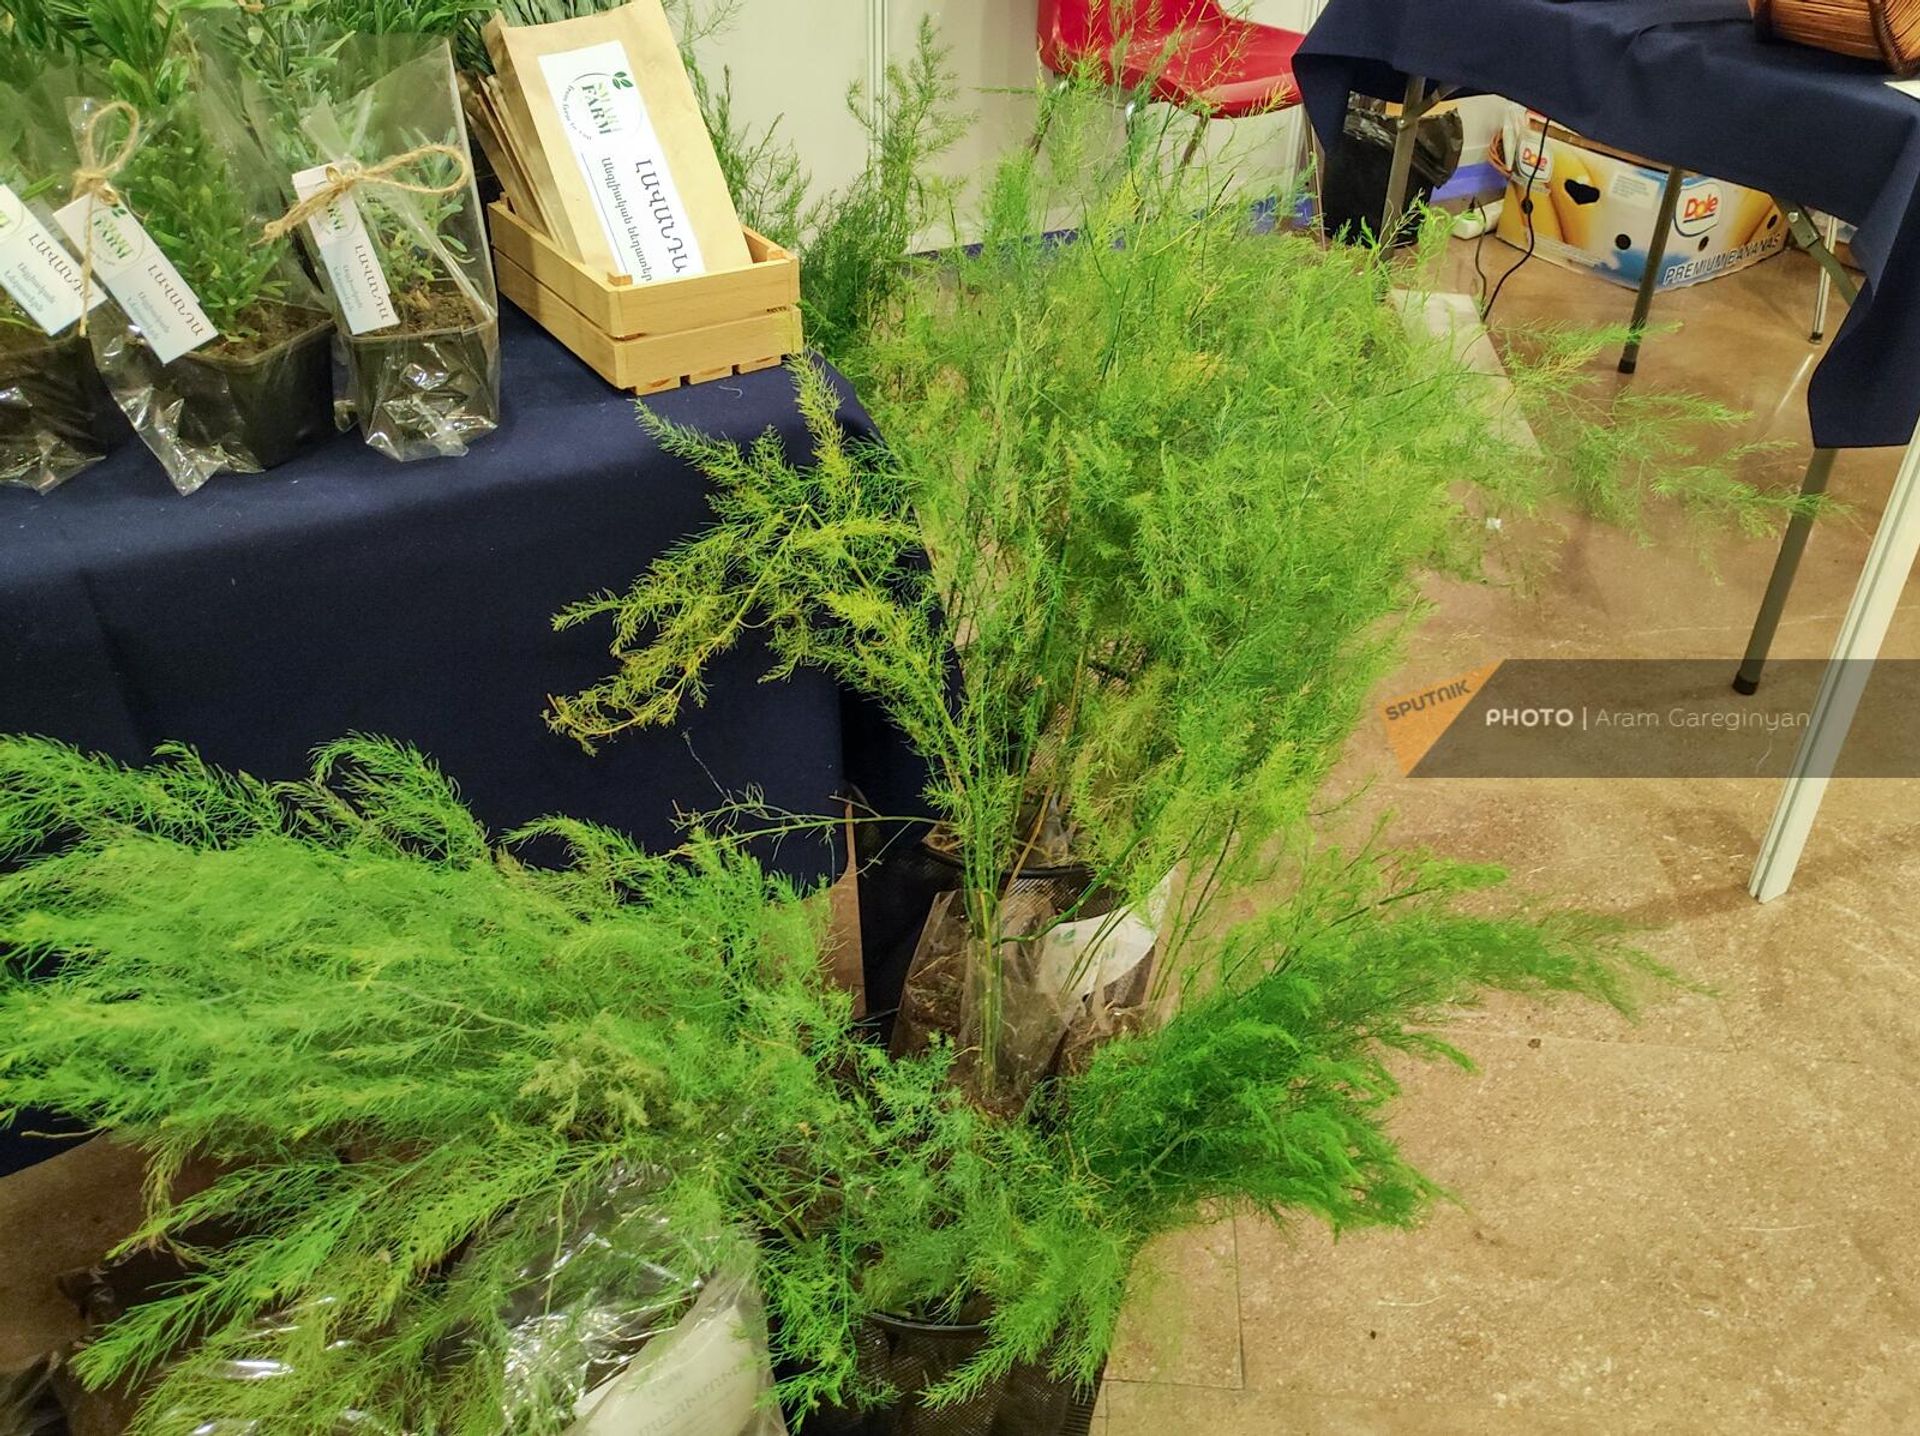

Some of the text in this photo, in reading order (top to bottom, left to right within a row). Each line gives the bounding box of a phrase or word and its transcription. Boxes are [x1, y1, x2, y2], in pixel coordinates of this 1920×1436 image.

[581, 85, 612, 134] FARM
[634, 159, 688, 273] ԼԱՎԱՆԴԱ
[1684, 194, 1718, 218] Dole
[1664, 232, 1780, 285] PREMIUM BANANAS
